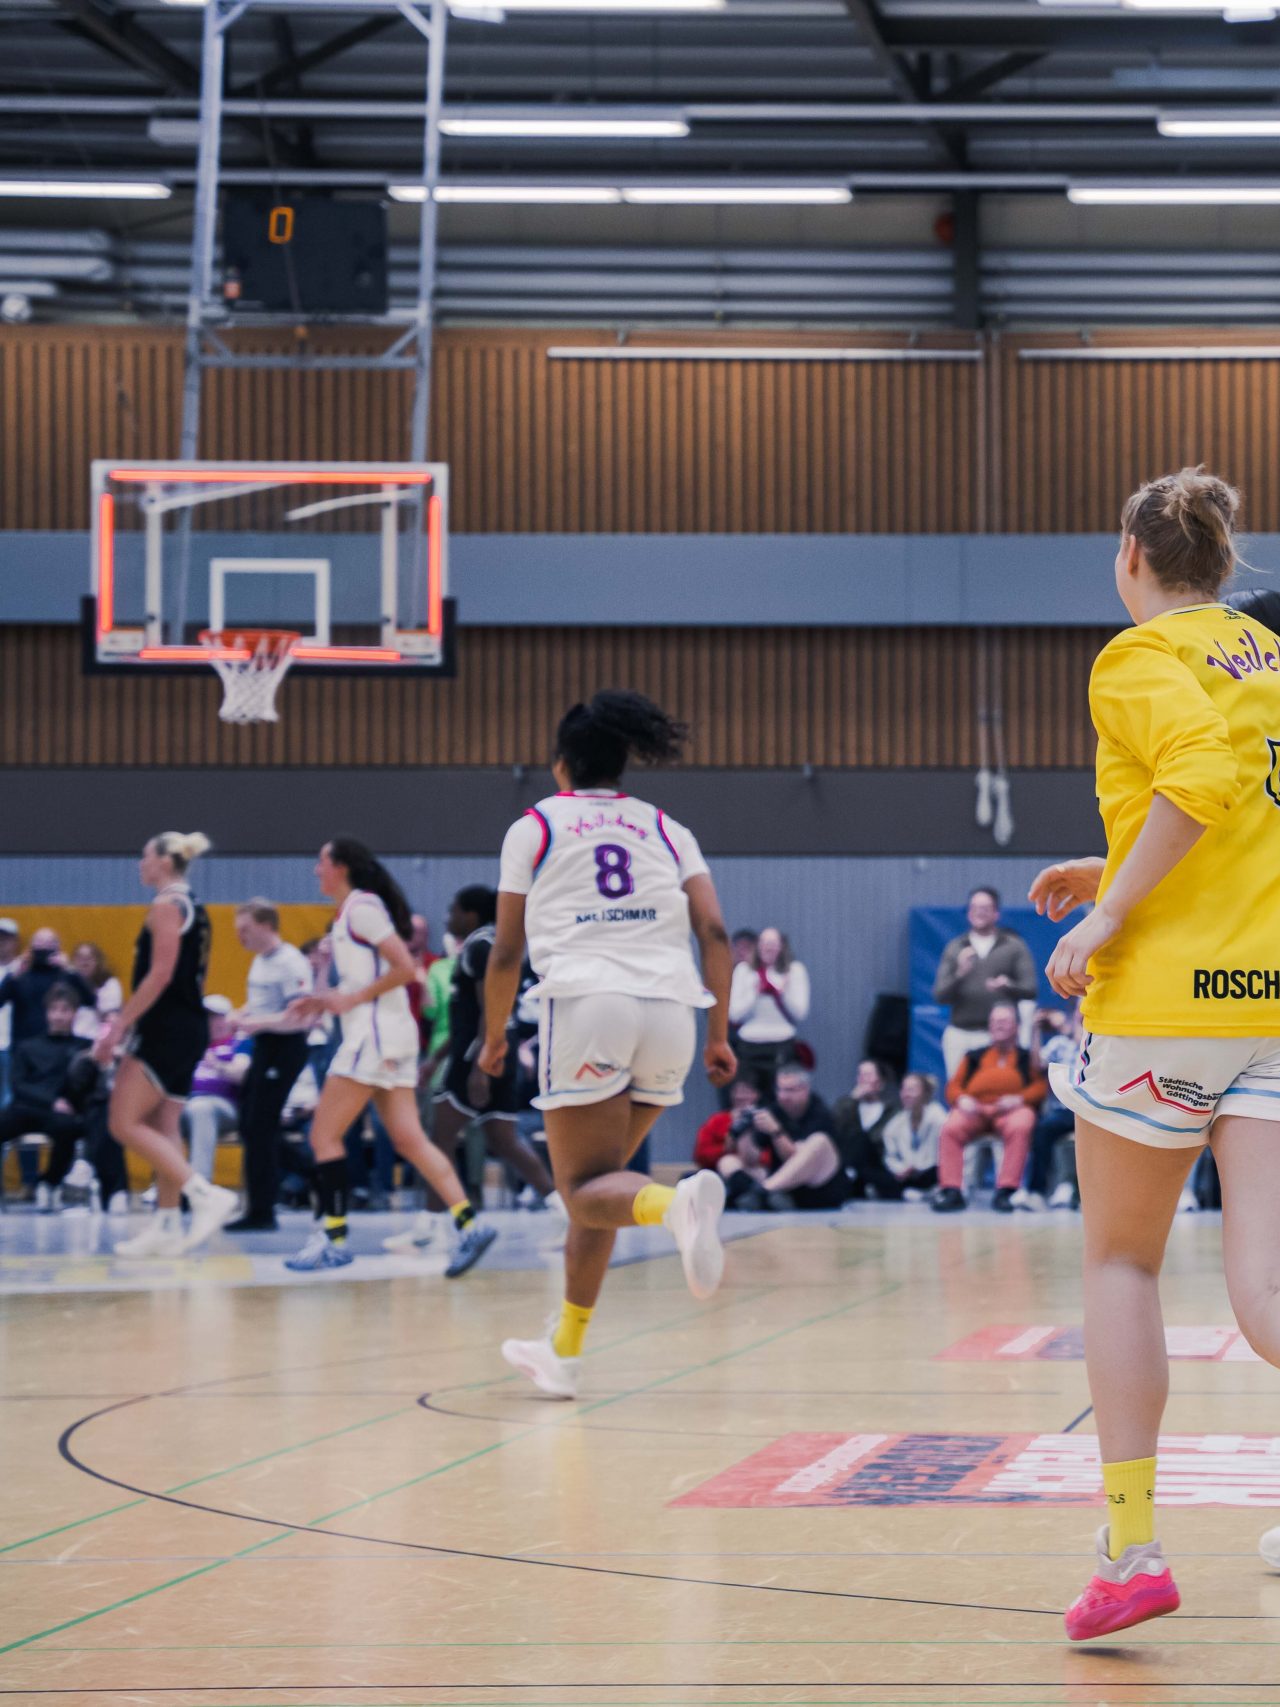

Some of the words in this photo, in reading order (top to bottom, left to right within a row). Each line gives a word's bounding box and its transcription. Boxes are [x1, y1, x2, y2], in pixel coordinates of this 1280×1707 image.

[269, 207, 294, 243] 0
[594, 843, 634, 899] 8
[1158, 1076, 1203, 1091] Städtische
[1166, 1090, 1209, 1107] Göttingen
